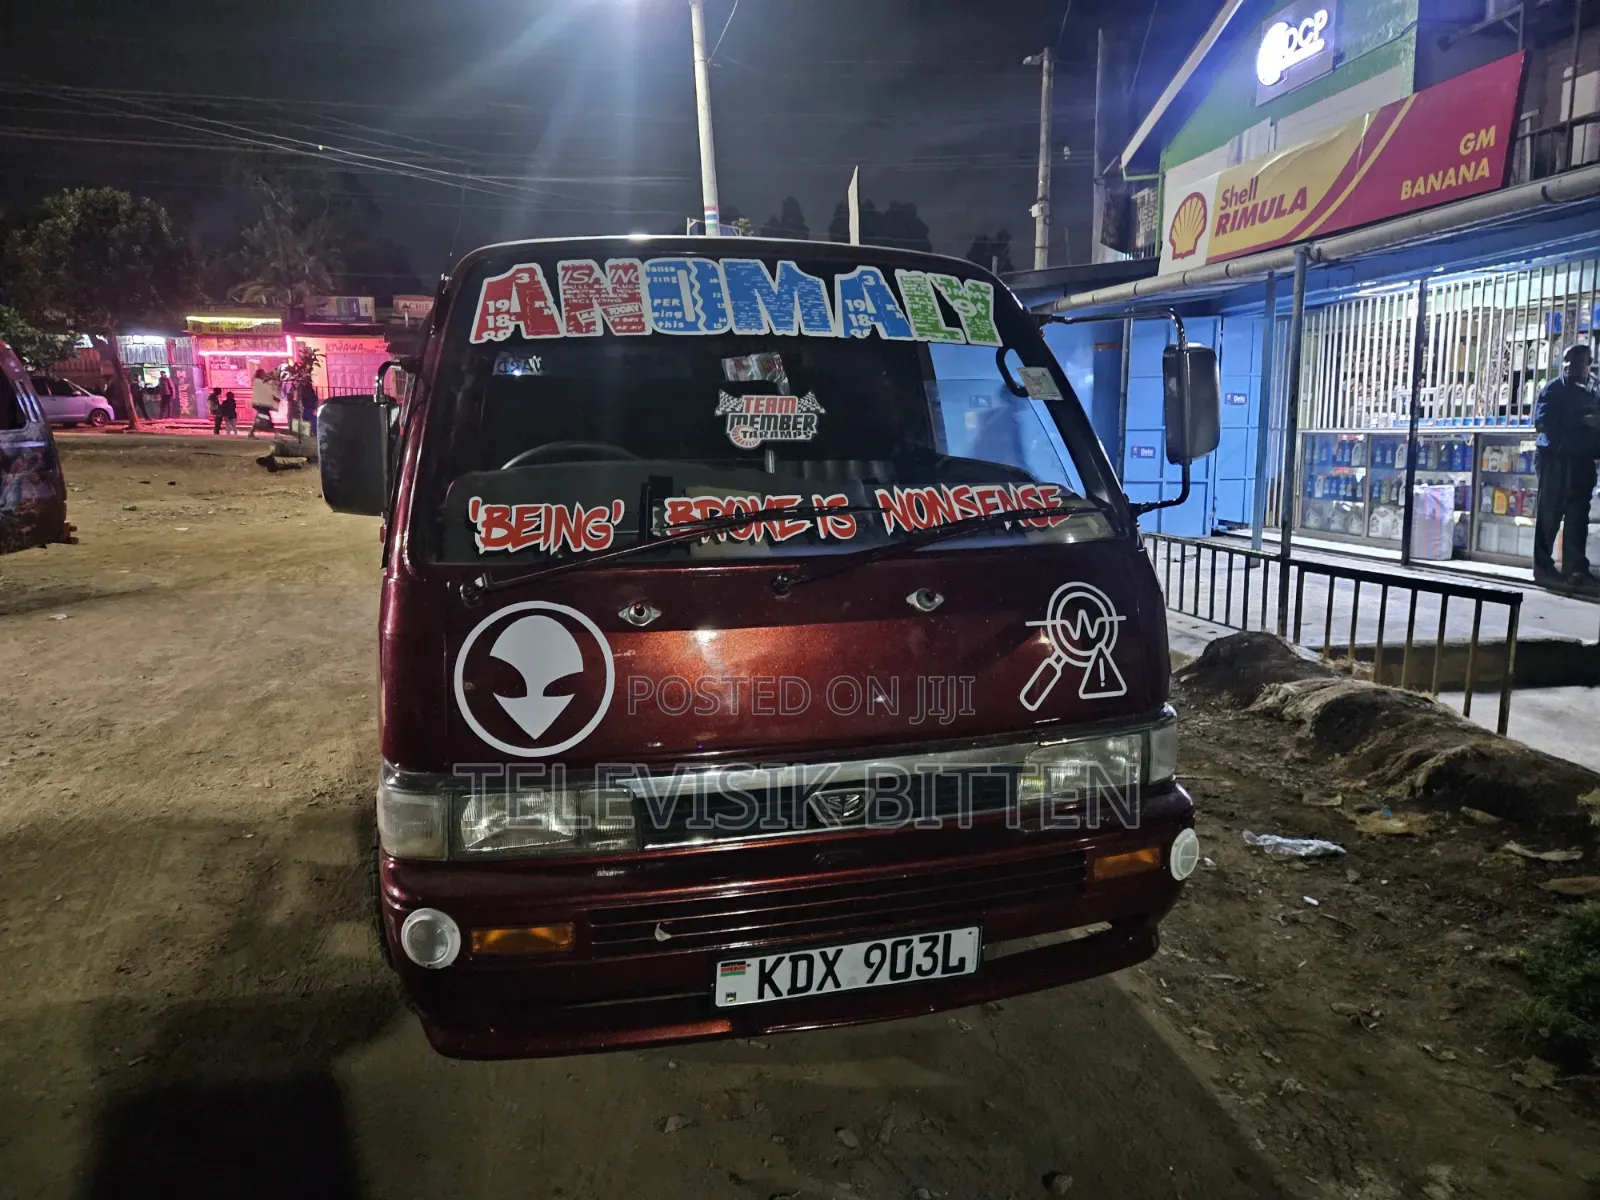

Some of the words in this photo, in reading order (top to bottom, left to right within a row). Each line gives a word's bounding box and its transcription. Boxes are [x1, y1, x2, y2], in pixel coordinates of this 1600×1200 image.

[1459, 125, 1495, 156] GM
[1220, 178, 1257, 211] Shell
[1401, 157, 1490, 201] BANANA
[1215, 186, 1307, 238] RIMULA
[469, 257, 1004, 347] ANOMALY
[728, 413, 817, 432] MEMBER
[744, 397, 797, 414] TEAM
[740, 430, 812, 440] TARAMPS
[812, 493, 857, 540] IS
[874, 484, 1075, 536] NONSENSE
[757, 948, 843, 1000] KDX
[863, 932, 966, 984] 903L
